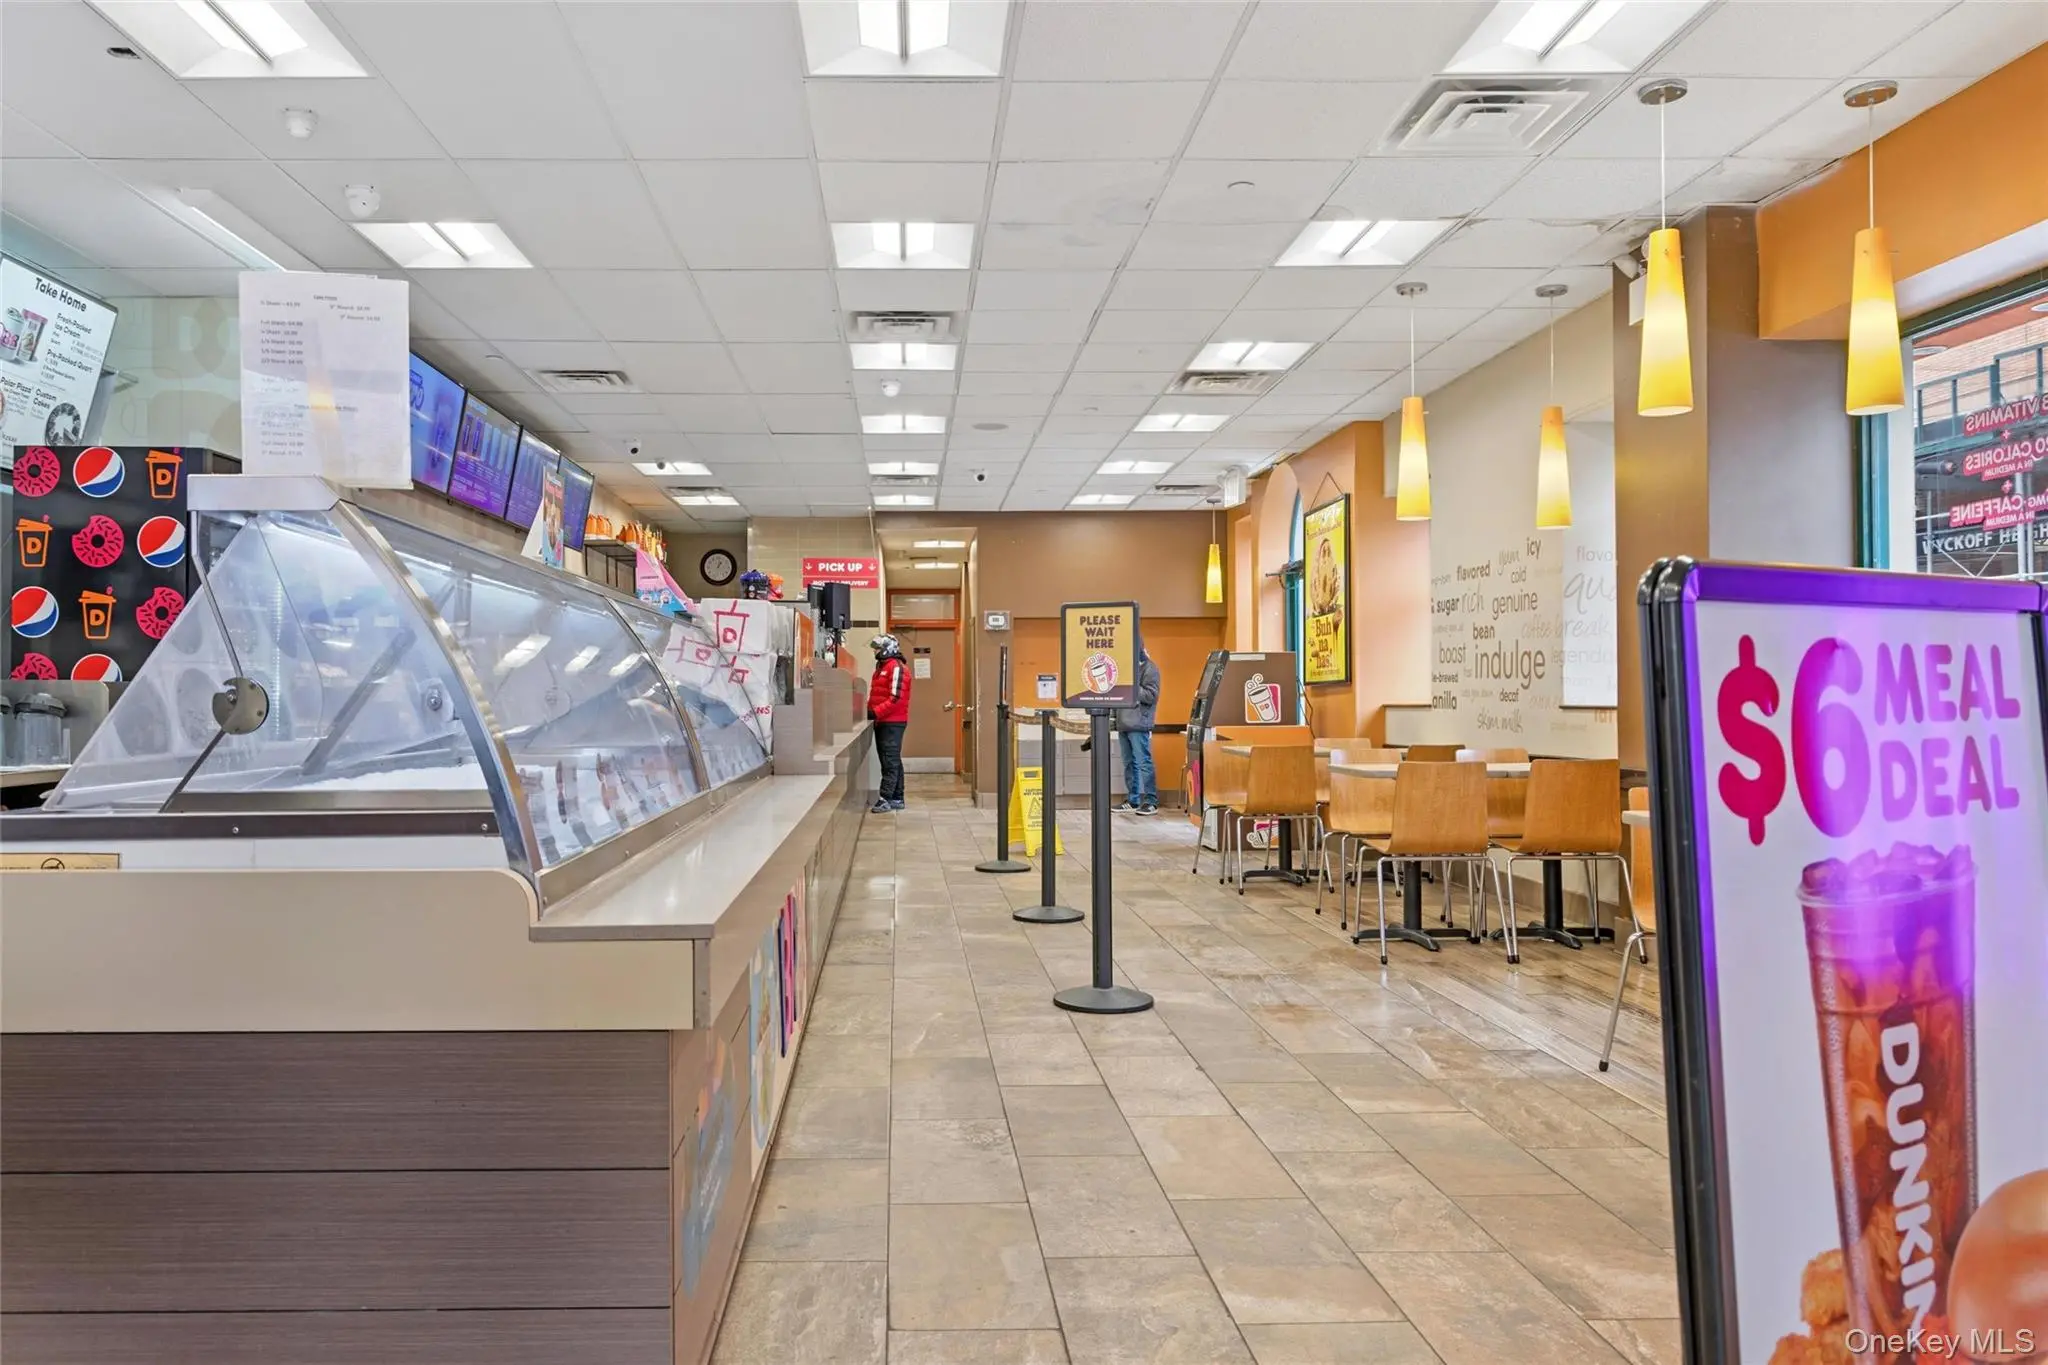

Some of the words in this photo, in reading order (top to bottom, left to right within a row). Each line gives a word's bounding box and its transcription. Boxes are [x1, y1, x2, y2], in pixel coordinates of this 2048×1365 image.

[35, 277, 58, 298] Take
[59, 289, 87, 312] Home
[1527, 537, 1541, 559] icy
[818, 563, 845, 572] PICK
[847, 563, 863, 572] UP
[1456, 560, 1490, 582] flavored
[1511, 566, 1527, 584] cold
[1437, 596, 1460, 616] sugar
[1461, 582, 1484, 614] rich
[1492, 591, 1538, 620] genuine
[1080, 615, 1120, 626] PLEASE
[1316, 617, 1332, 637] Buh
[1473, 622, 1495, 640] bean
[1085, 627, 1115, 637] WAIT
[1086, 638, 1114, 649] HERE
[1319, 638, 1328, 652] na
[1439, 642, 1466, 664] boost
[1475, 640, 1546, 689] indulge
[1499, 687, 1520, 704] decaf
[1875, 643, 2021, 726] MEAL
[1717, 634, 1870, 846] $6
[1879, 734, 2020, 822] DEAL
[1881, 1022, 1937, 1345] DUNKIN
